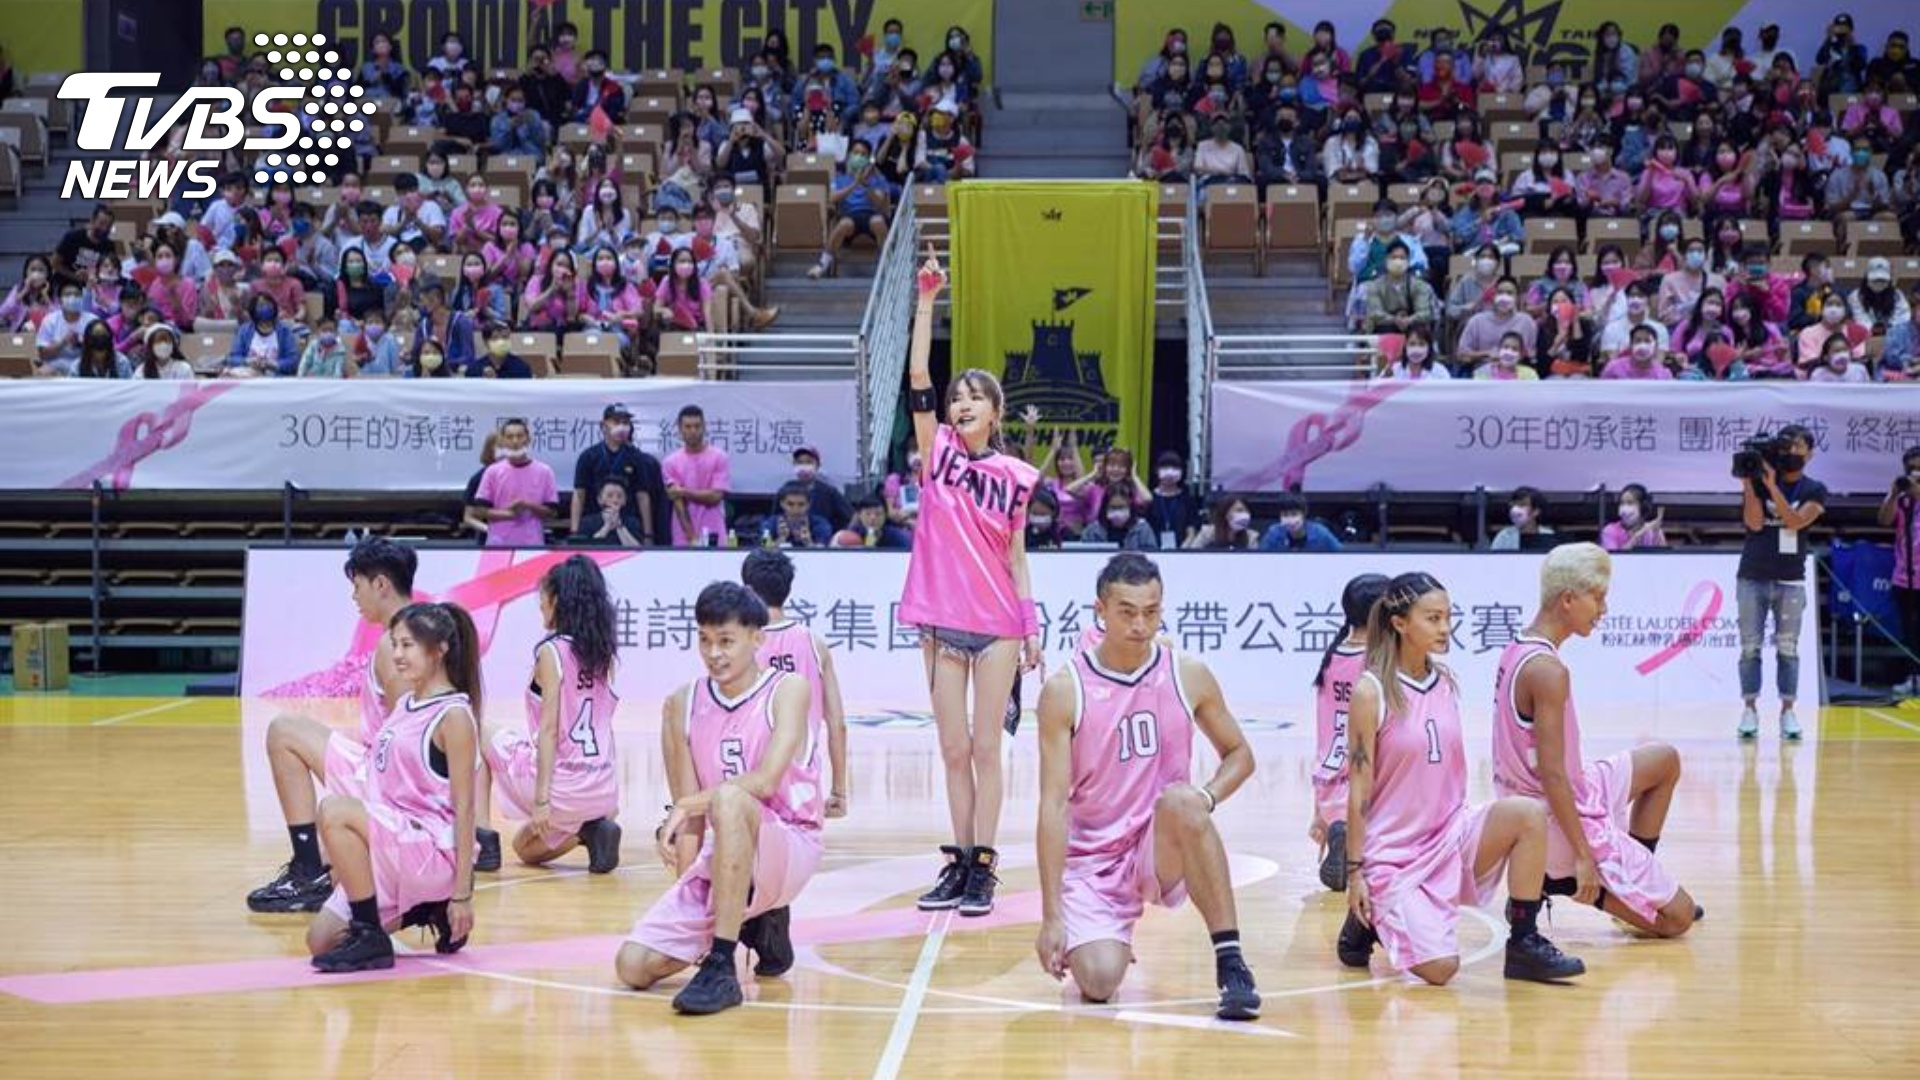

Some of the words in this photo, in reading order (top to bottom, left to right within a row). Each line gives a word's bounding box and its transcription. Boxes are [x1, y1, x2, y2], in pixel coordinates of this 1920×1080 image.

[583, 0, 704, 72] THE
[719, 0, 873, 72] CITY
[279, 414, 475, 451] 30年的承諾
[1455, 414, 1657, 452] 30年的承諾
[930, 446, 1028, 520] JEANNE
[568, 697, 599, 758] 4
[1117, 710, 1160, 763] 10
[1424, 718, 1442, 764] 1
[719, 738, 747, 782] 5
